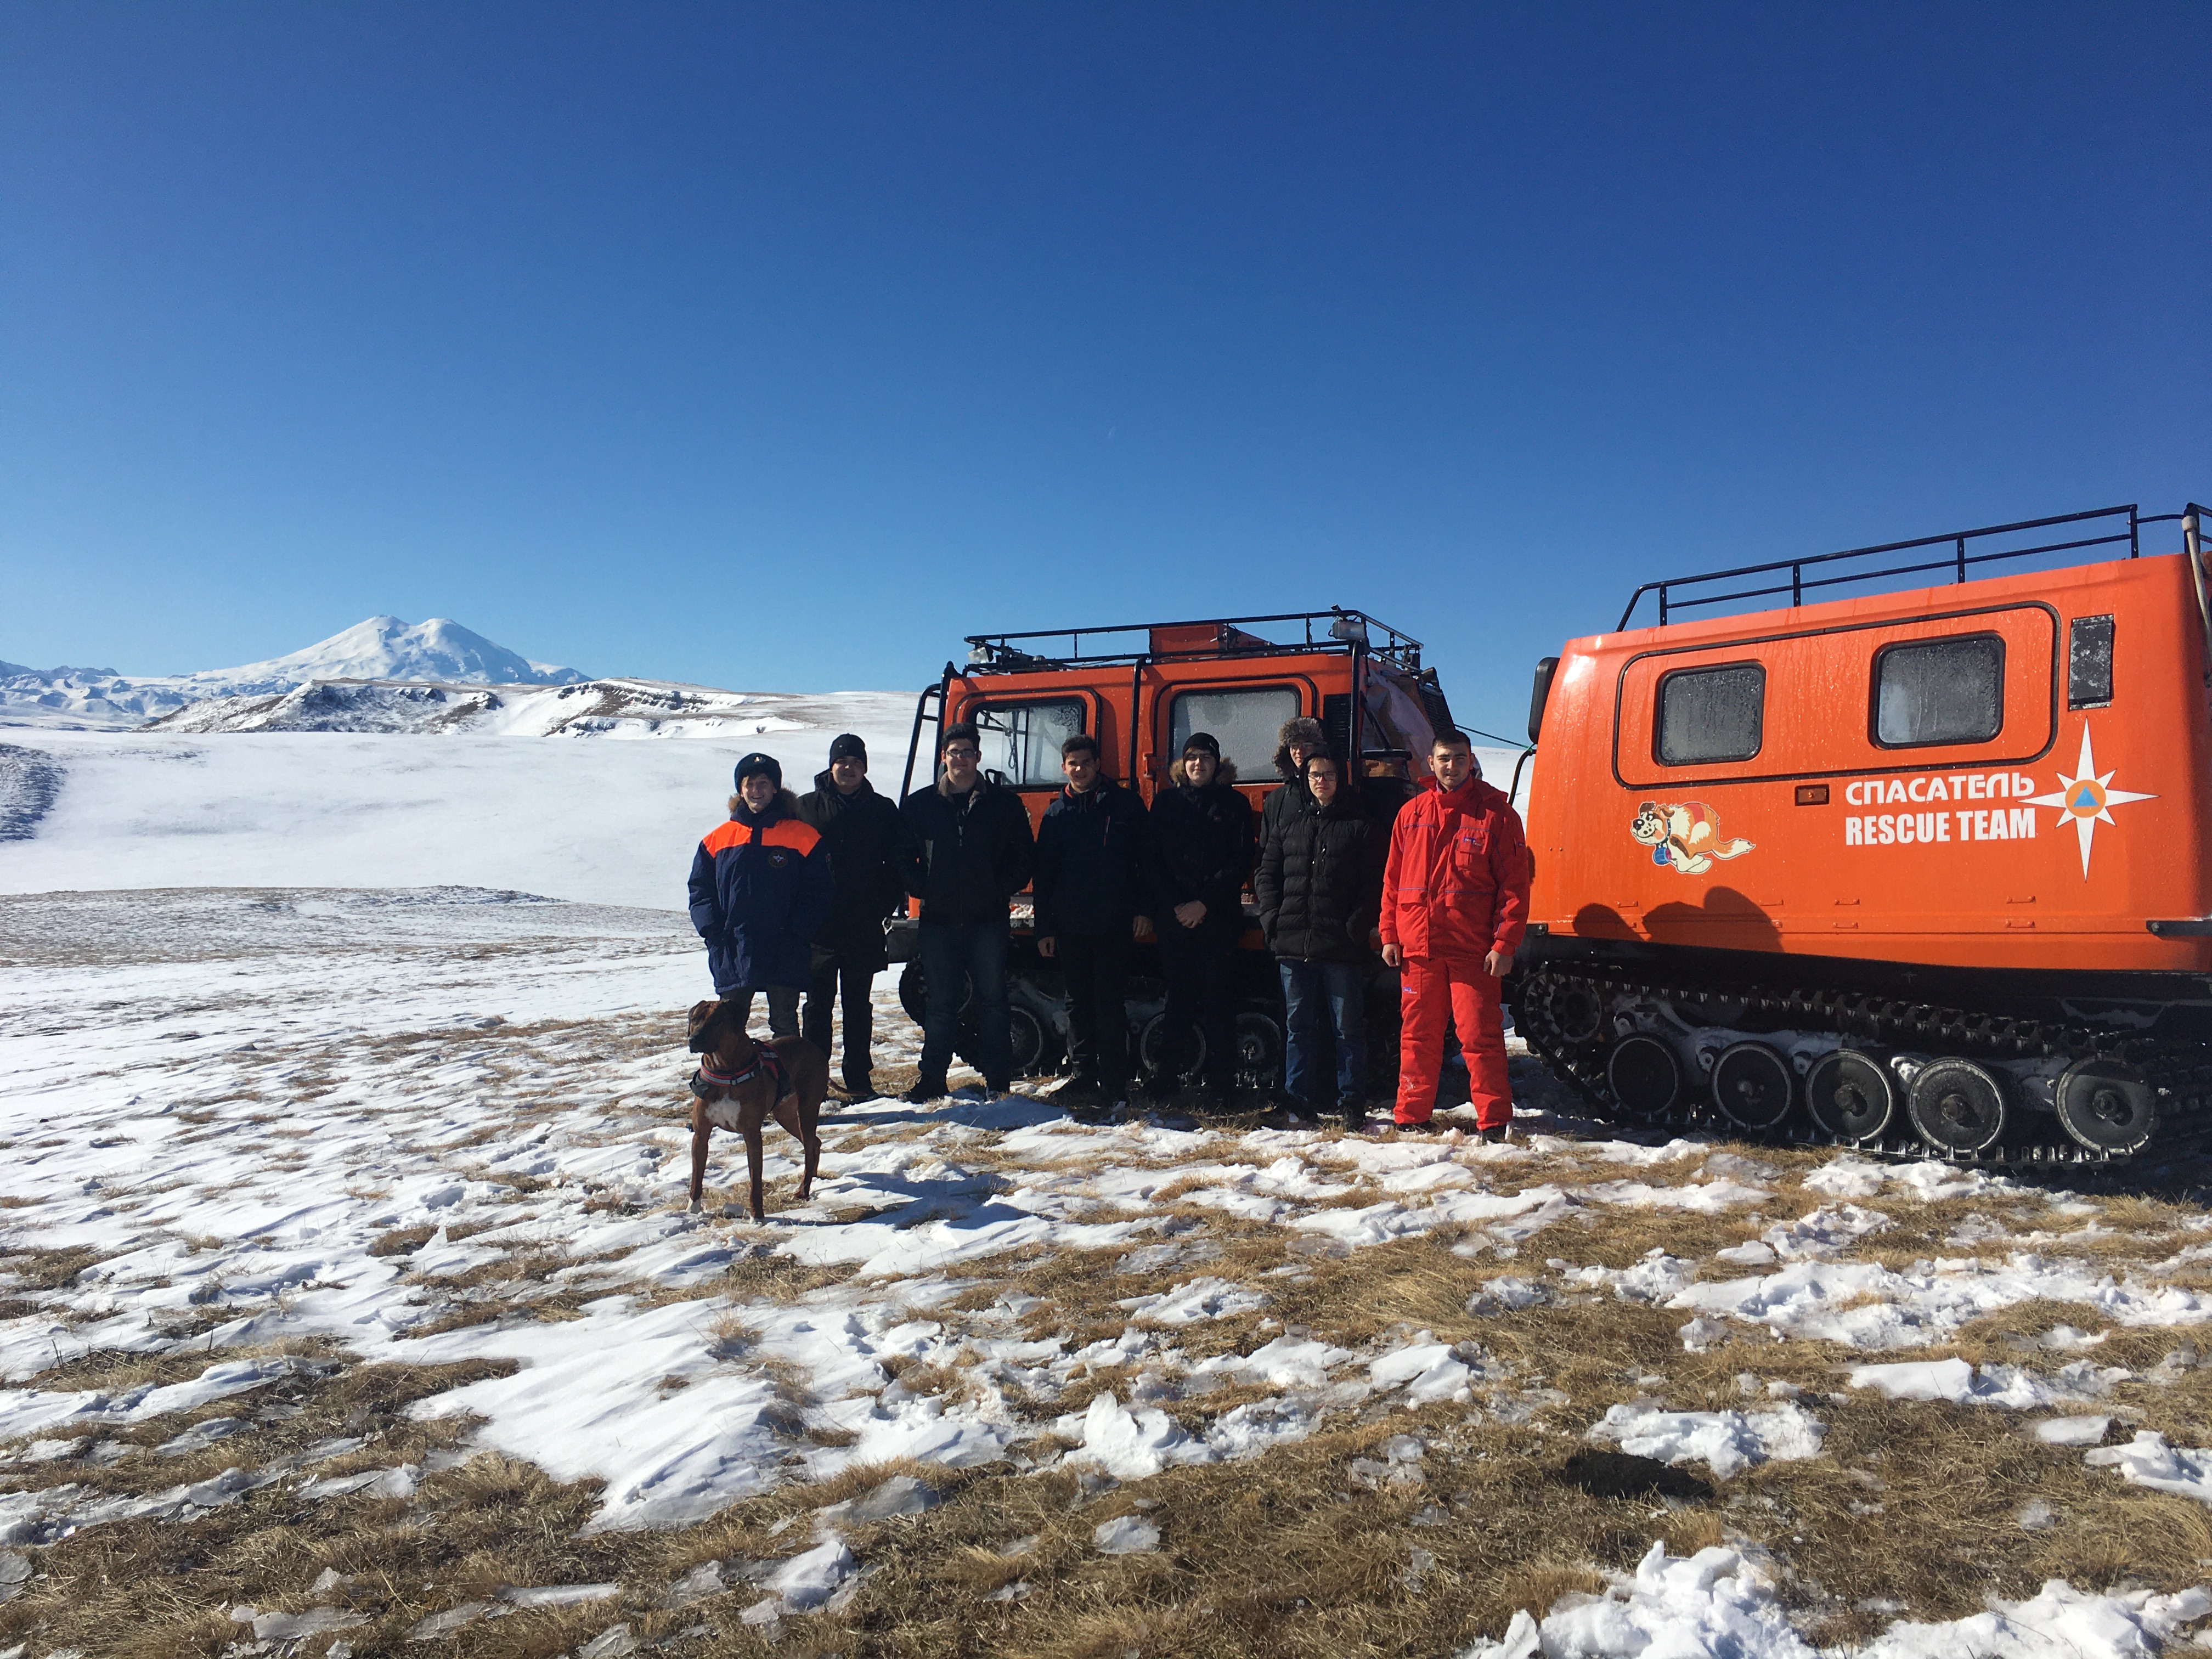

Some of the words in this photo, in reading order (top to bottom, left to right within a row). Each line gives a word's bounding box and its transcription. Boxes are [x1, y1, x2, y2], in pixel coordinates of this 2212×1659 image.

[1845, 772, 2035, 805] СПАСАТЕЛЬ
[1846, 812, 1950, 845] RESCUE
[1956, 808, 2036, 841] TEAM
